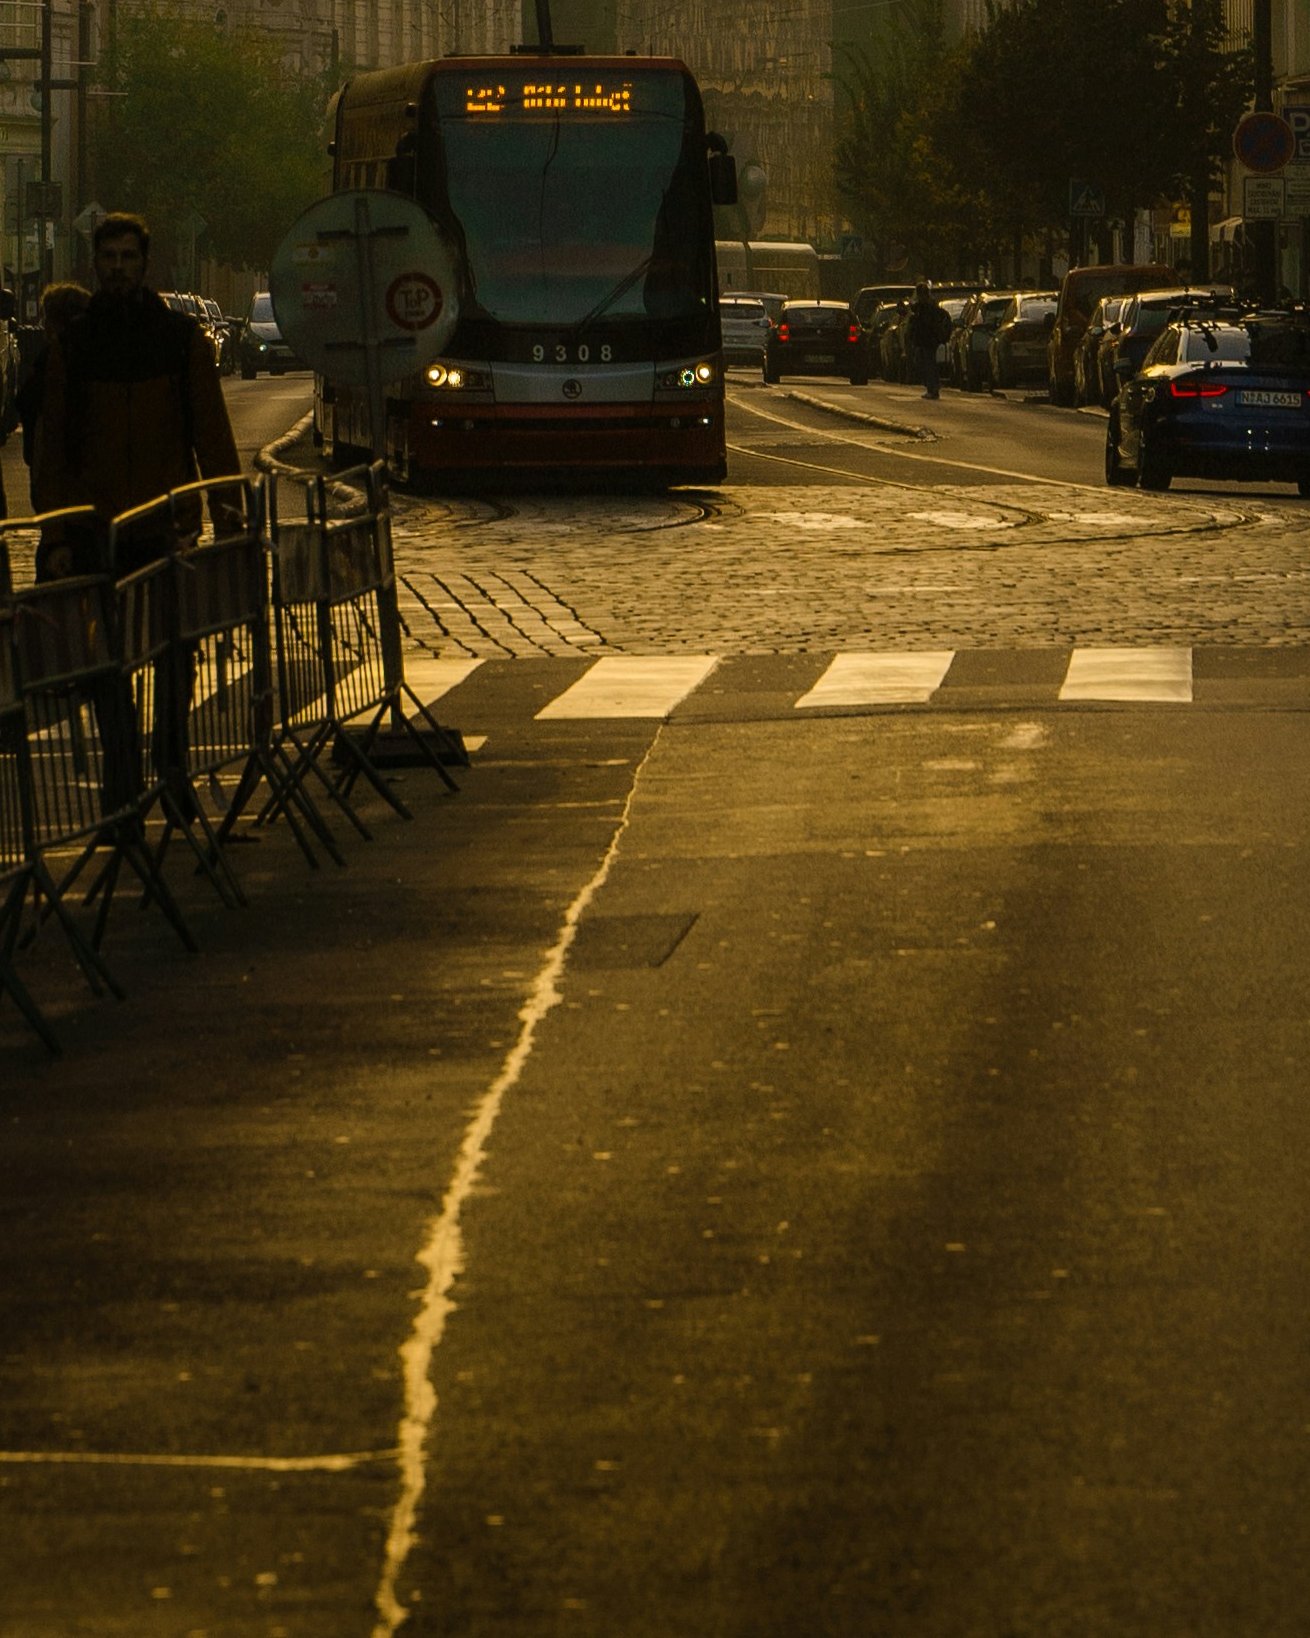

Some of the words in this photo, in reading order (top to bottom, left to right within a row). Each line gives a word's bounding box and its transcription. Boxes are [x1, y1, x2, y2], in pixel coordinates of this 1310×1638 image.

[532, 342, 614, 365] 9308
[1241, 392, 1250, 403] N
[1273, 394, 1300, 406] 6615
